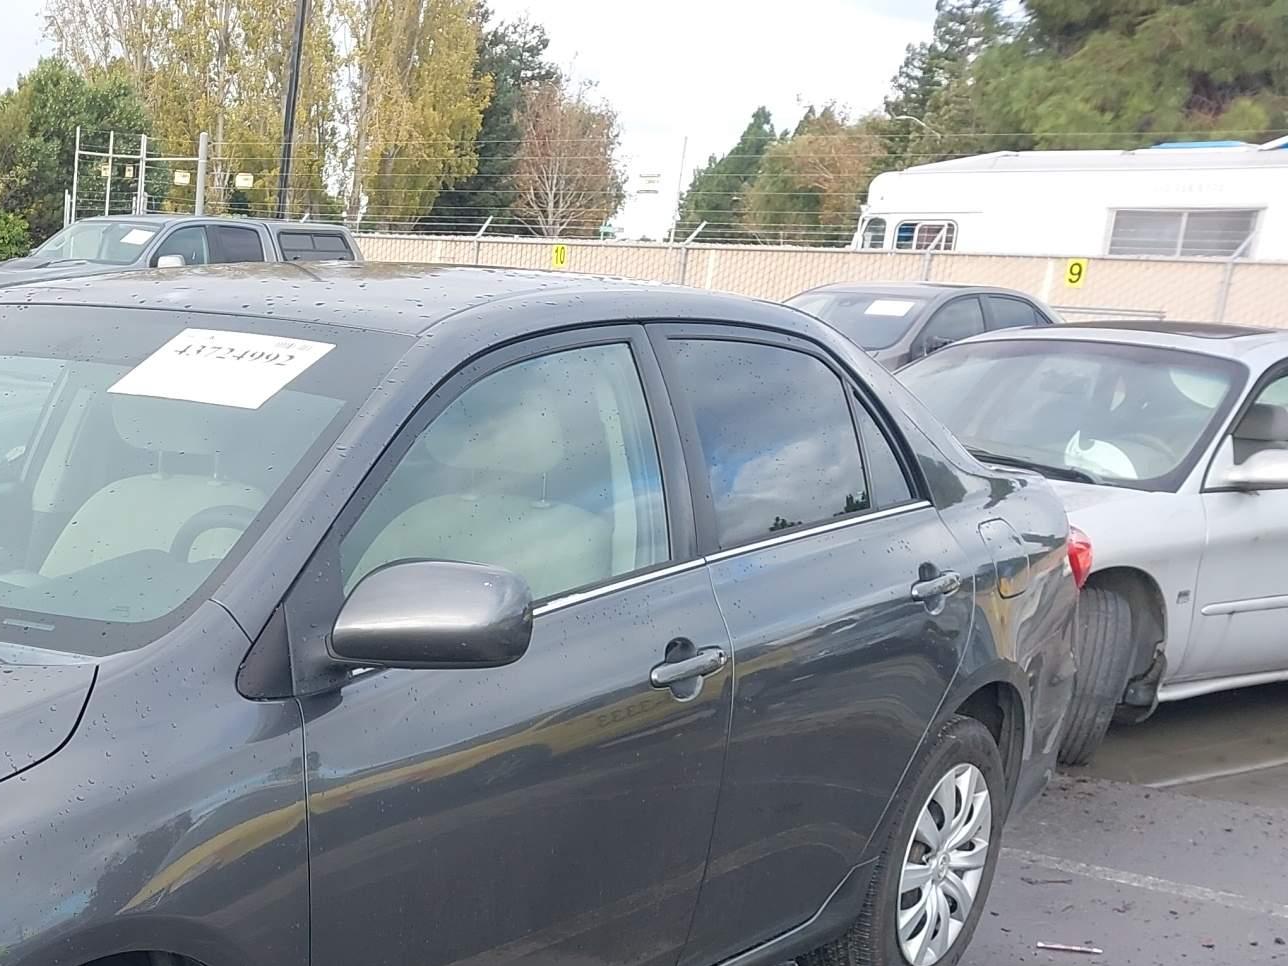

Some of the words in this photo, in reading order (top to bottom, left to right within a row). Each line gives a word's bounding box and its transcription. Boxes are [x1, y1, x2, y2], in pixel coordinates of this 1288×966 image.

[554, 246, 566, 265] 10
[1068, 262, 1083, 284] 9
[173, 343, 295, 367] 43724992
